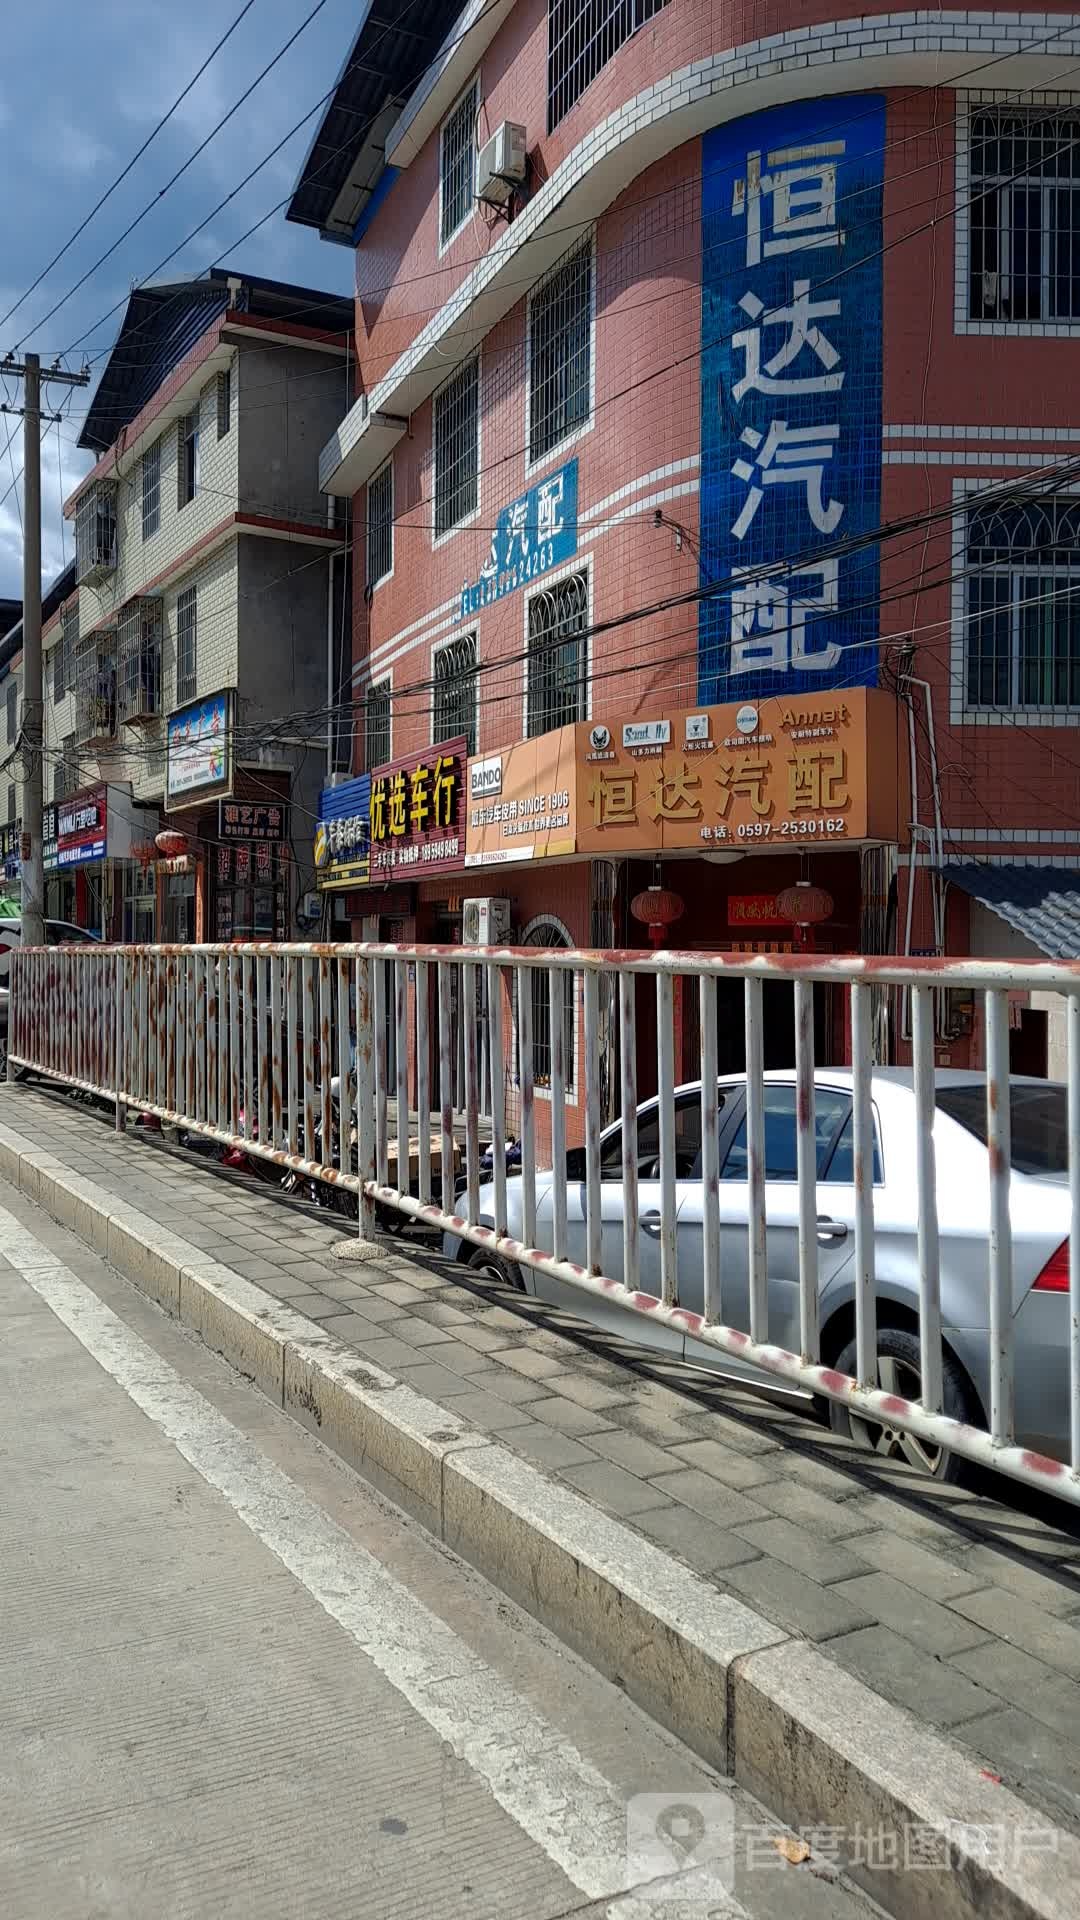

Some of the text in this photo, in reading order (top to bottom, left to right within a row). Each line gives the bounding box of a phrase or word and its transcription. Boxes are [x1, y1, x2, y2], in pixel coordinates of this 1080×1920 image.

[730, 140, 846, 675] 恒达汽配
[782, 704, 848, 727] Annat
[370, 755, 454, 840] 优选车行
[472, 766, 501, 789] BANDO
[590, 750, 849, 824] 恒达汽配
[519, 795, 545, 816] SINCE
[547, 791, 569, 809] 1906
